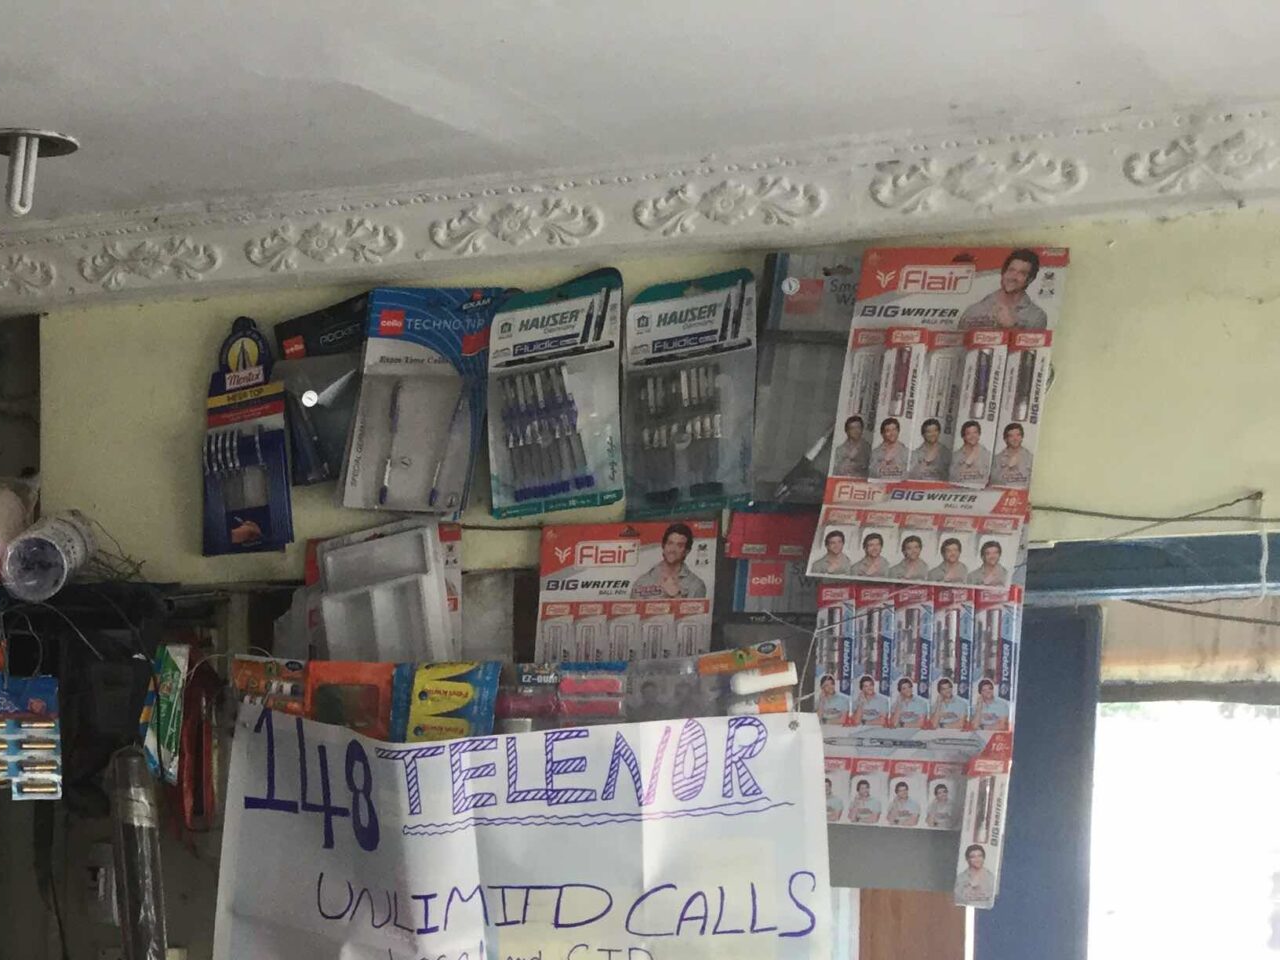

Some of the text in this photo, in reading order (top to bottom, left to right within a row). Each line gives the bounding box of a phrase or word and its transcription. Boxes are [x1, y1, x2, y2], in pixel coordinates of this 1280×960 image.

[903, 269, 969, 292] Flair
[380, 319, 403, 328] cello
[406, 318, 462, 330] TECHNO
[519, 308, 580, 333] HAUSER
[657, 303, 718, 328] HAUSER
[861, 305, 959, 318] BIG WRITER
[837, 482, 978, 503] Flair BIG WRITER
[579, 545, 634, 564] Flair
[546, 579, 631, 591] BIG WRITER
[751, 574, 782, 585] cello
[842, 640, 851, 678] TOPPER
[882, 641, 892, 679] TOPPER
[920, 642, 930, 680] TOPPER
[960, 643, 970, 681] TOPPER
[1002, 643, 1012, 682] TOPPER
[244, 708, 772, 852] 148 TELENOR
[625, 870, 817, 938] CALLS
